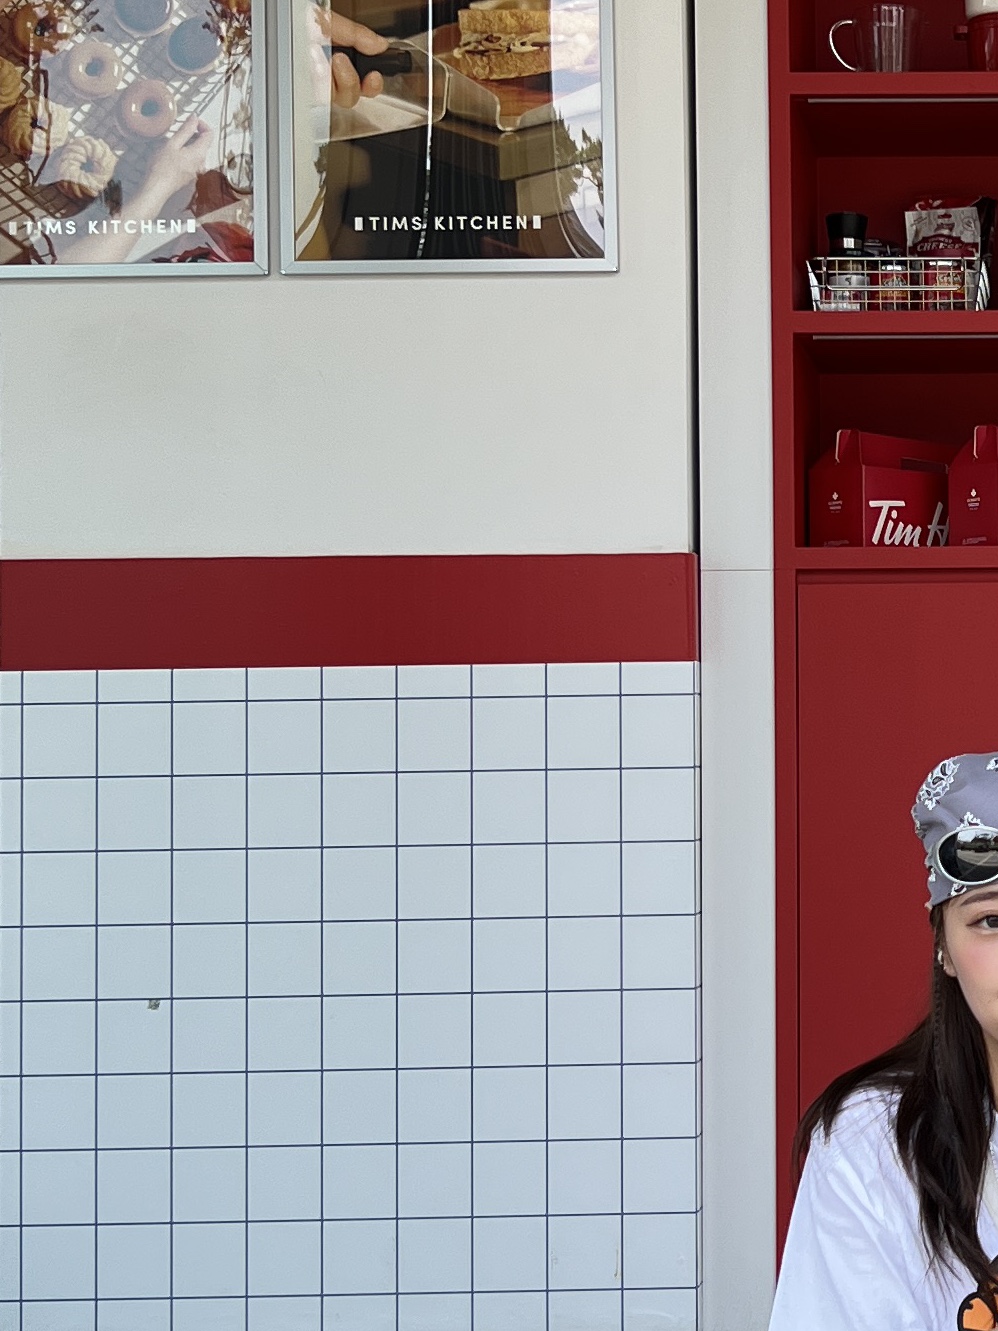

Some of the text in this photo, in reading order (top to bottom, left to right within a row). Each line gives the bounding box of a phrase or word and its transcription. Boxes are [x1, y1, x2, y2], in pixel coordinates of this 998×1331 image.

[24, 219, 182, 236] TIMS KITCHEN
[369, 215, 527, 232] TIMS KITCHEN
[868, 500, 922, 548] Tim
